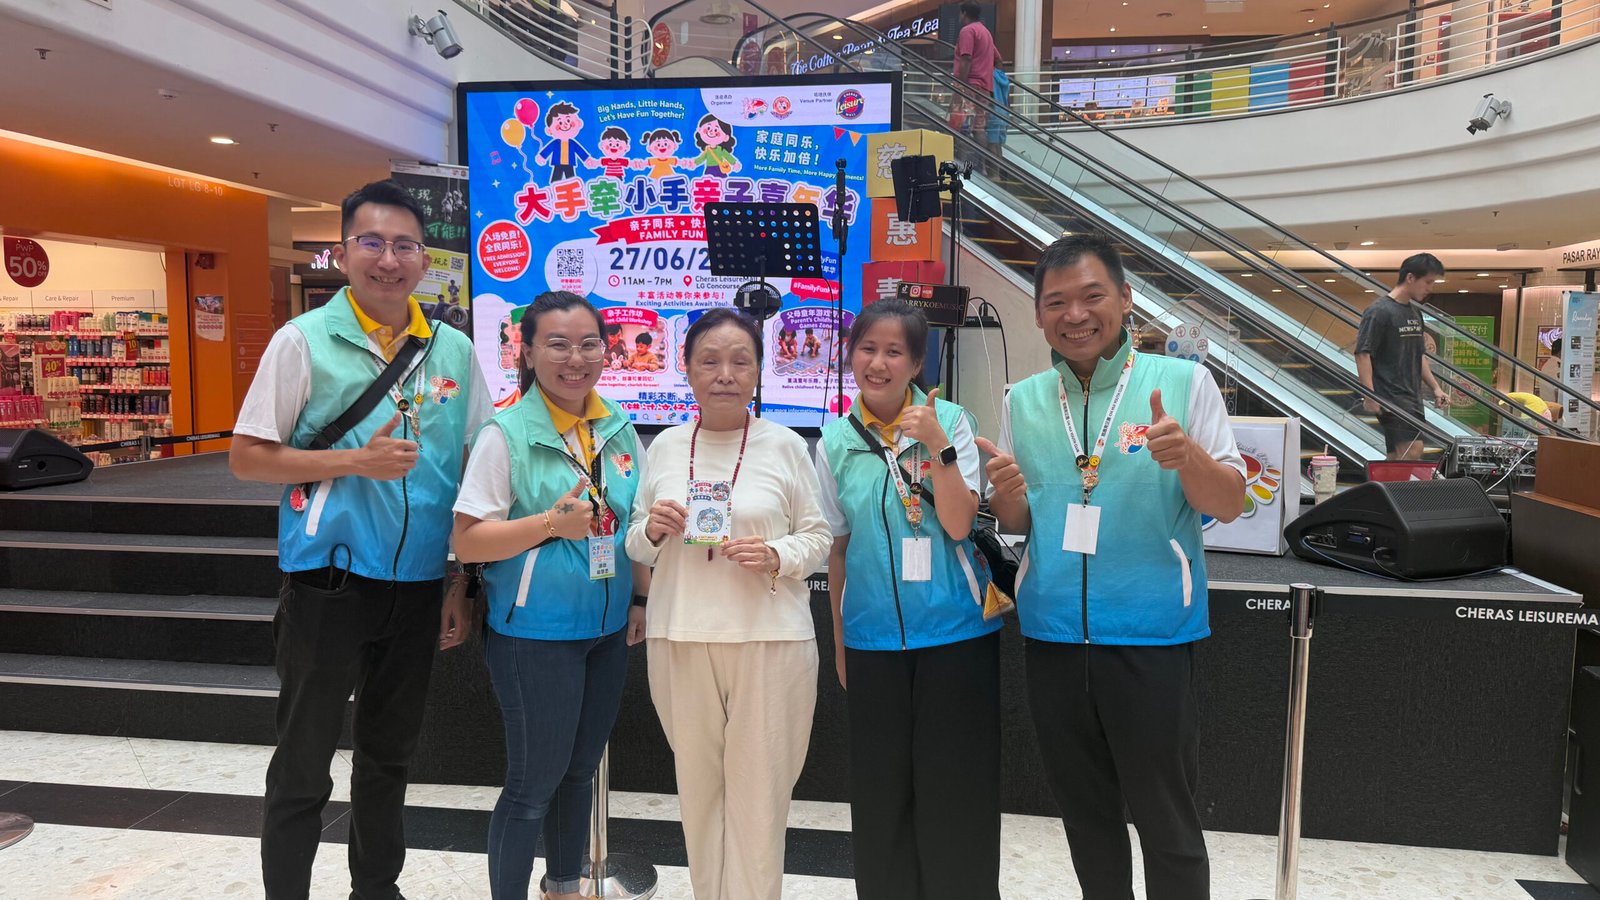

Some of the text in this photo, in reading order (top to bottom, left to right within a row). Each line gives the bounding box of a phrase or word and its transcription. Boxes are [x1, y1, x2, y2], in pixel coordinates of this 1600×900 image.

[887, 26, 910, 40] Tea
[597, 105, 610, 113] Big
[611, 101, 636, 110] Hands,
[660, 100, 685, 110] Hands,
[599, 113, 616, 123] Let's
[617, 112, 635, 120] Have
[650, 110, 685, 119] Together!
[768, 166, 786, 174] Family
[168, 175, 186, 188] LOT
[189, 179, 201, 192] LG
[639, 230, 704, 240] FAMILY FUN
[885, 212, 919, 246] 惠
[1562, 248, 1600, 264] PASAR RAY
[493, 260, 519, 268] EVERYONE
[622, 276, 645, 286] 11AM
[654, 276, 672, 286] 7PM
[695, 275, 719, 283] Cheras
[636, 300, 662, 308] Exciting
[714, 299, 728, 307] You!
[1245, 598, 1291, 611] CHERA
[1455, 606, 1599, 626] CHERAS LEISUREMA
